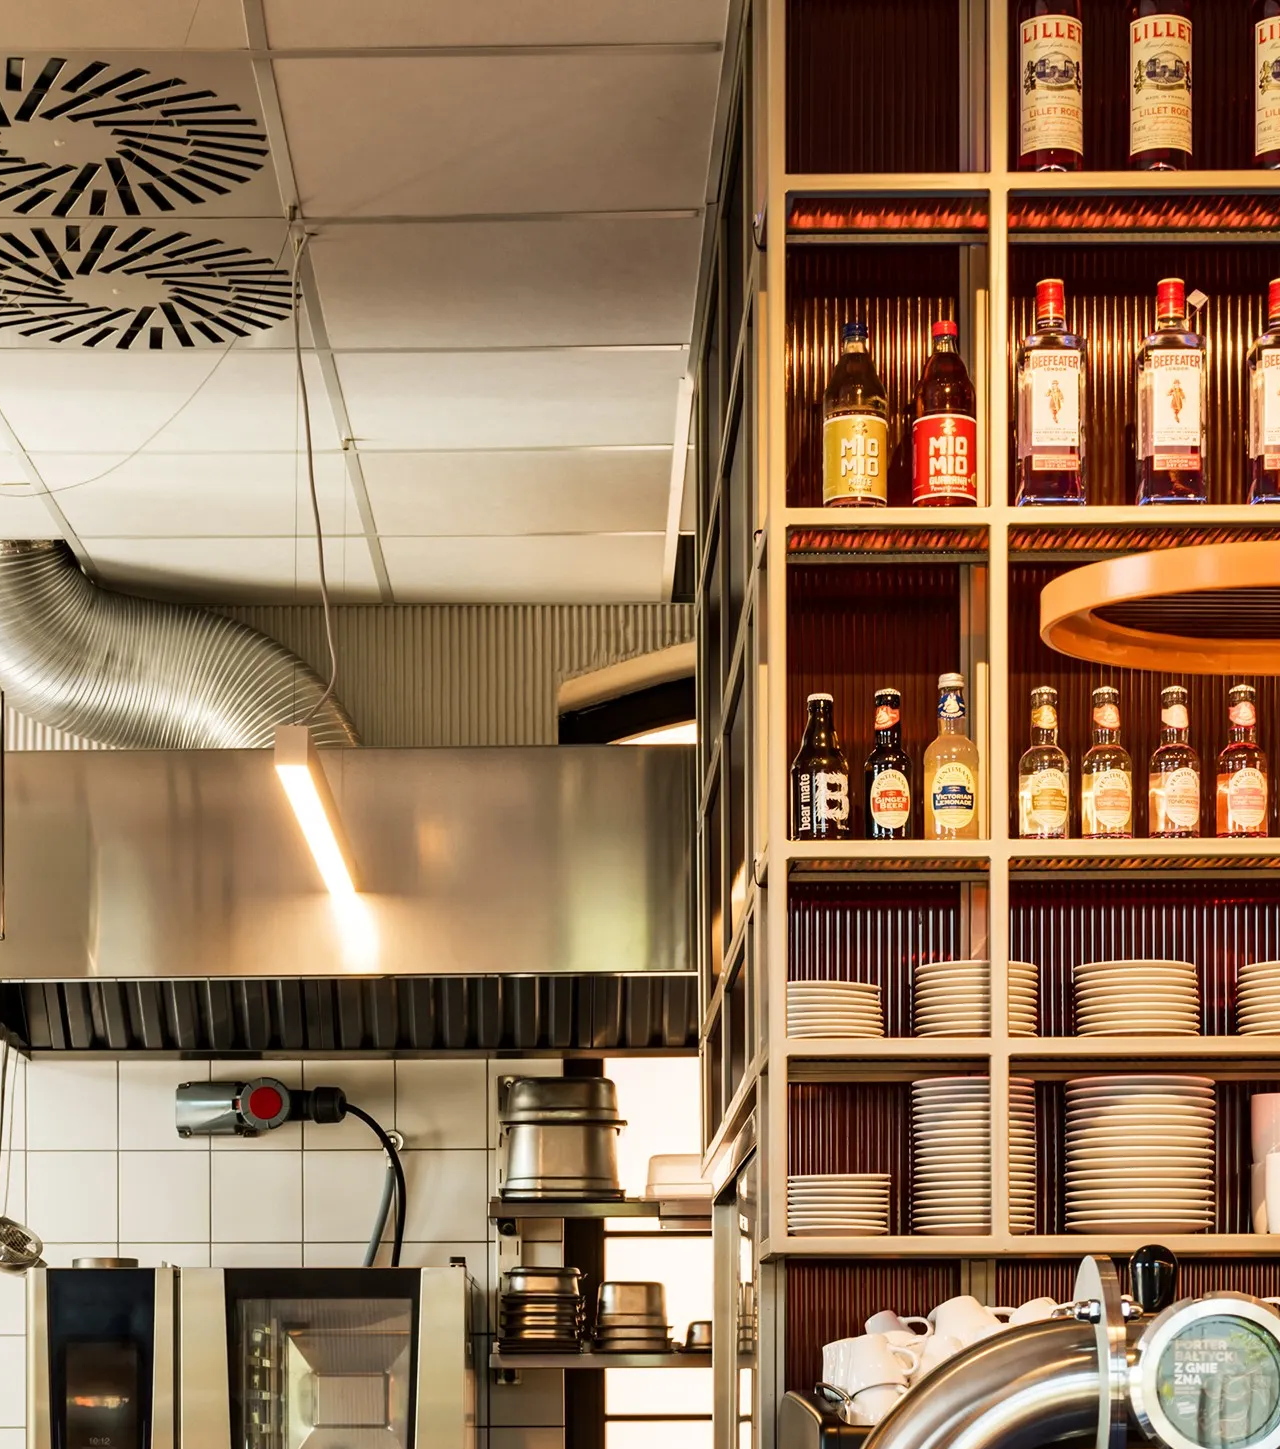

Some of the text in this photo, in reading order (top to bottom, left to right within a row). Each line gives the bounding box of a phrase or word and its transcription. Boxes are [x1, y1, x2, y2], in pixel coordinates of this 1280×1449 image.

[1029, 106, 1058, 118] LILLET
[1139, 106, 1168, 118] LILLET
[1032, 355, 1079, 370] BEEFEATER
[1154, 354, 1201, 370] BEEFEATER
[840, 436, 879, 457] MIO
[929, 436, 967, 456] MIO
[840, 457, 879, 477] MIO
[929, 456, 967, 476] MIO
[799, 773, 811, 831] bear mate
[1174, 1339, 1227, 1351] PORTER
[1174, 1362, 1218, 1374] Z GNIE
[1174, 1374, 1202, 1385] ZNA
